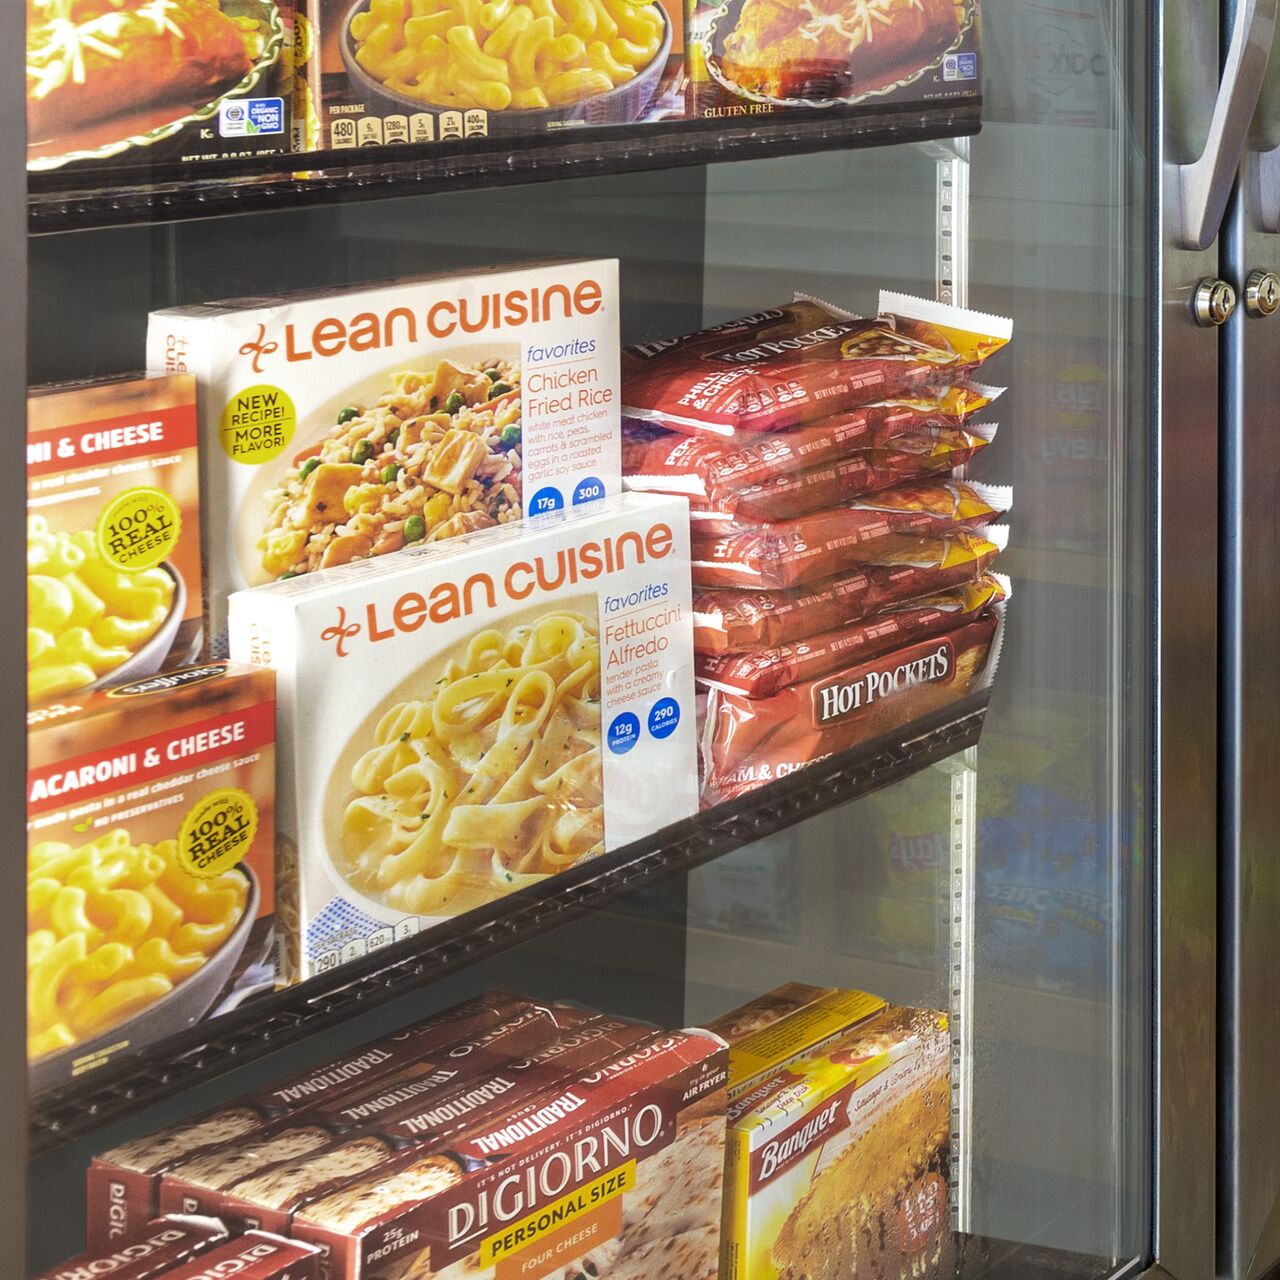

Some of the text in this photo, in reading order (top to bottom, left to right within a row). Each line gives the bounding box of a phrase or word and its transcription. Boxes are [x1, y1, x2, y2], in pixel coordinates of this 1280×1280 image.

[705, 103, 774, 118] GLUTEN FREE
[527, 338, 596, 362] favorites
[604, 582, 669, 614] favorites
[605, 603, 682, 646] Fettuccini
[606, 635, 669, 670] Alfredo
[820, 646, 948, 721] HOT POCKETS
[615, 723, 633, 738] 12g
[654, 706, 673, 722] 290
[683, 1071, 727, 1103] AIR FRYER
[758, 1099, 842, 1182] Banquet
[448, 1103, 663, 1244] DIGIORNO
[491, 1172, 627, 1258] PERSONAL SIZE
[521, 1223, 598, 1274] FOUR CHEESE
